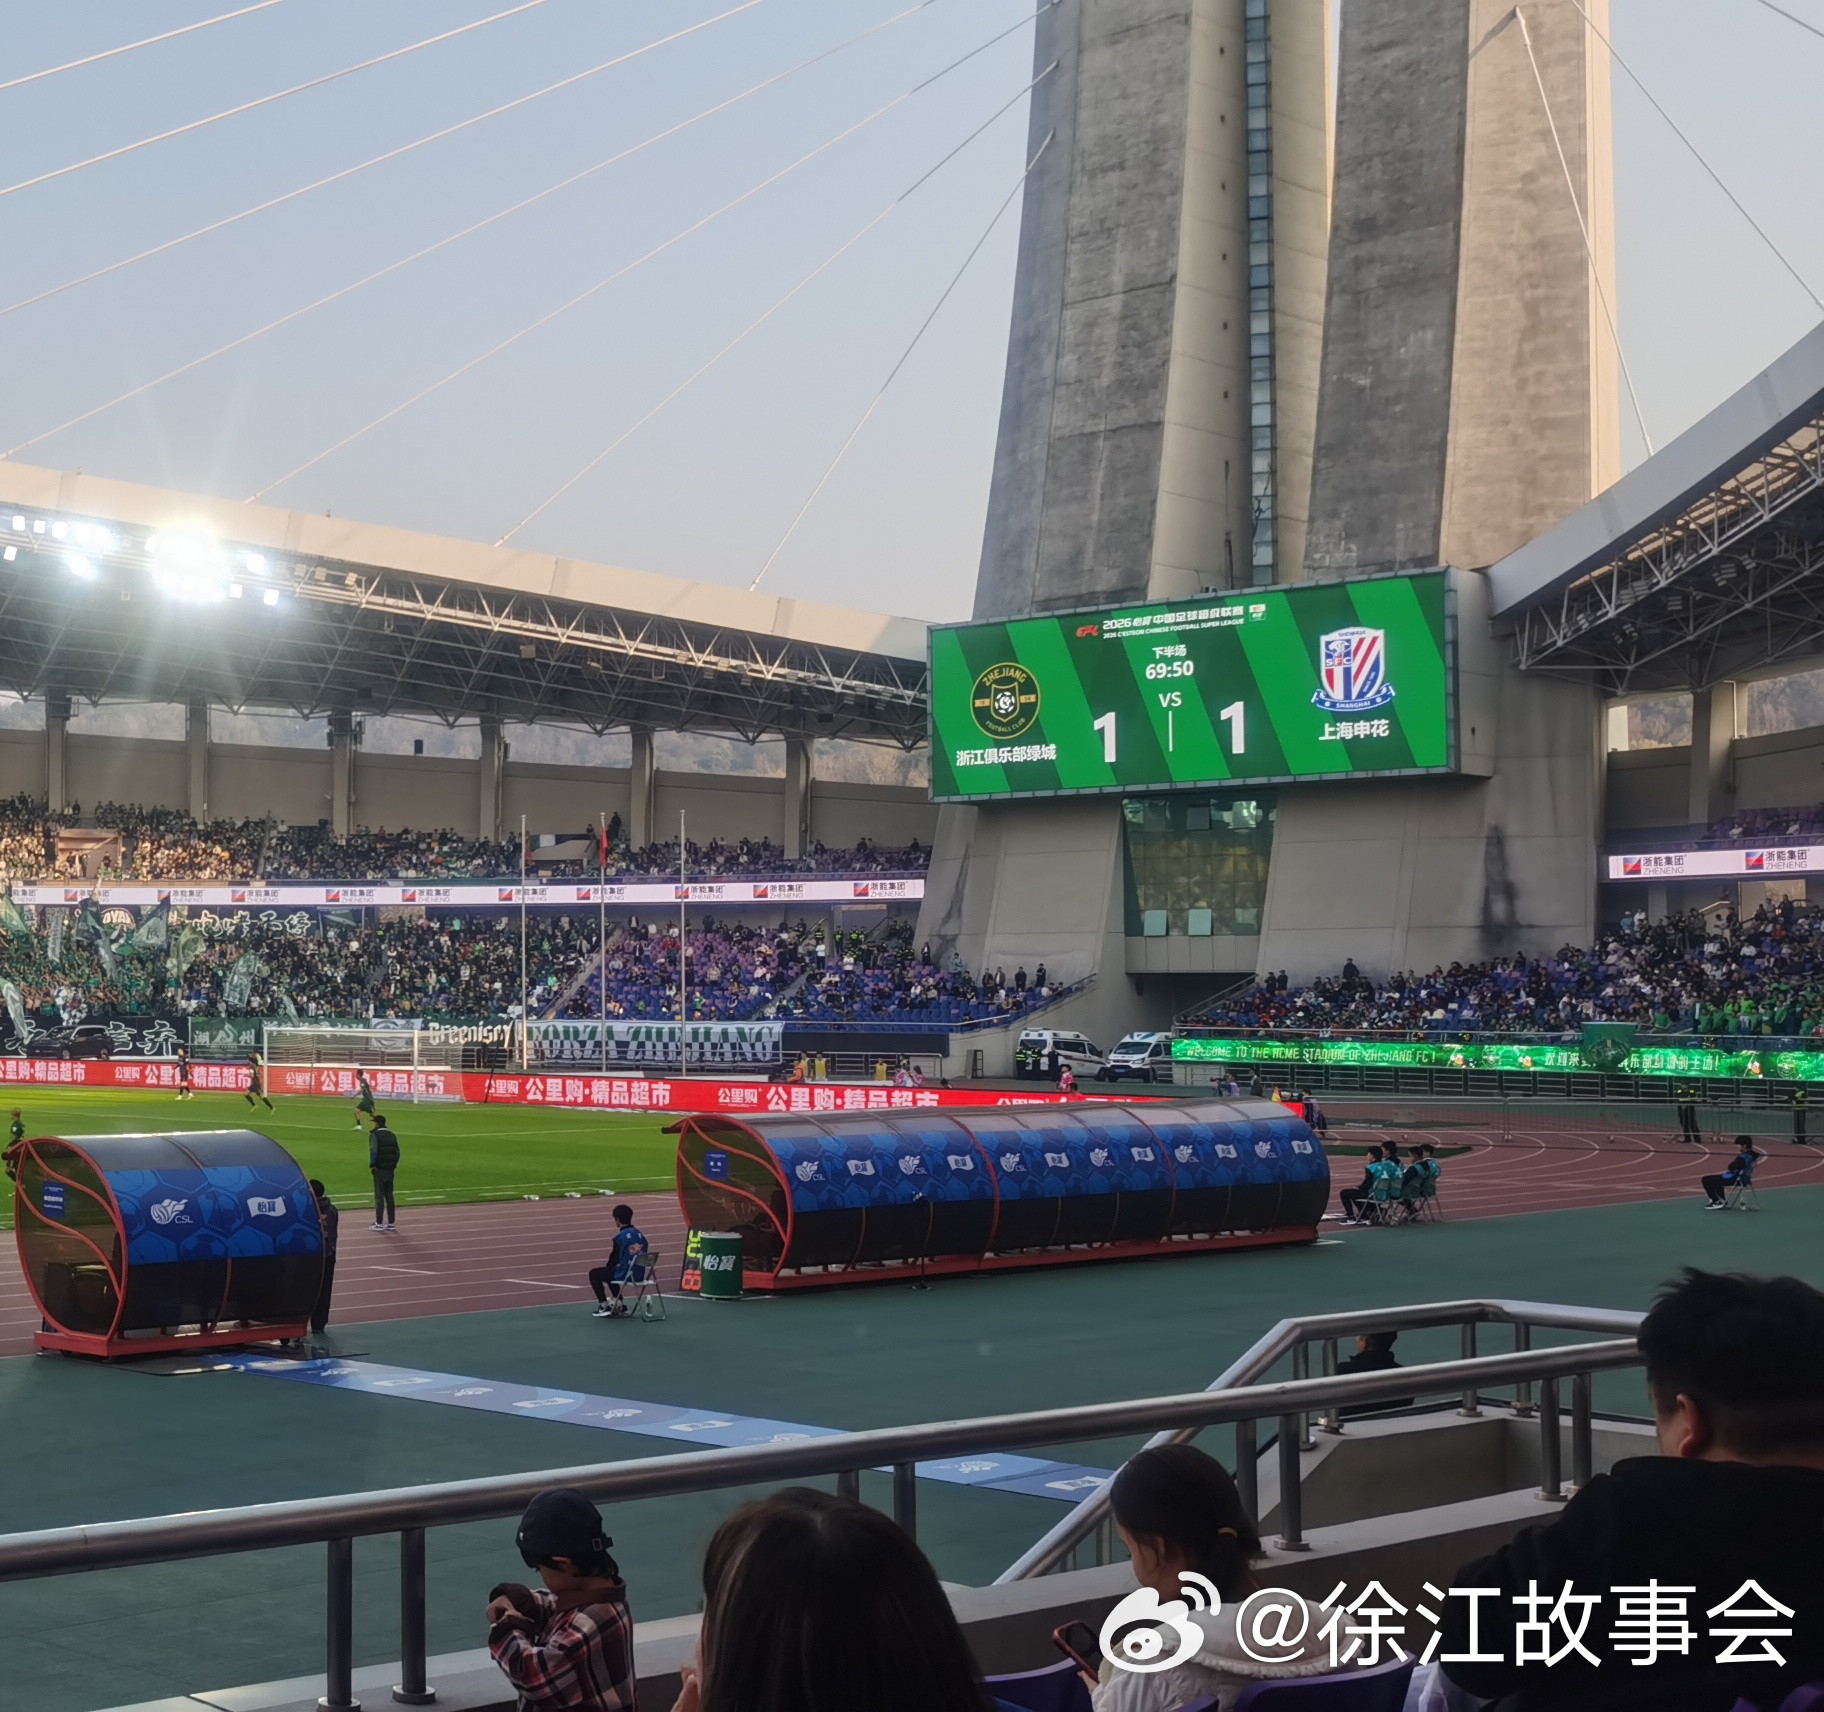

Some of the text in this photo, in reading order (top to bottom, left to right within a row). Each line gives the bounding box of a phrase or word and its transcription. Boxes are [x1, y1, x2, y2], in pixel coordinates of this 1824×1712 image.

[1103, 618, 1131, 630] 2026
[1153, 605, 1244, 625] 中国足球超级联赛
[1152, 644, 1187, 659] 下半场
[1325, 656, 1352, 666] SFC
[982, 667, 1028, 686] ZHEJIANG
[1145, 660, 1194, 680] 69:50
[1158, 692, 1182, 708] VS
[1336, 700, 1371, 708] SHANGHAI
[1220, 701, 1245, 754] 1
[1318, 718, 1390, 740] 上海申花
[1093, 711, 1116, 763] 1
[956, 743, 1057, 767] 浙江俱乐部绿城
[1642, 856, 1684, 866] 浙能集团
[1766, 850, 1808, 861] 浙能集团
[1642, 866, 1684, 874] ZHENENG
[1766, 861, 1808, 869] ZHENENG
[770, 884, 803, 892] 浙能集团
[870, 882, 905, 890] 浙能集团
[1187, 1045, 1231, 1057] WELCOME
[1236, 1046, 1246, 1058] TO
[1251, 1047, 1268, 1059] THE
[1302, 1048, 1345, 1061] STADIUM
[1349, 1049, 1360, 1060] OF
[115, 1066, 140, 1079] 公里购
[485, 1077, 671, 1106] 公里购 公里购·精品超市
[717, 1088, 758, 1104] 公里购
[175, 1215, 194, 1223] CSL
[704, 1254, 736, 1271] 怡寶
